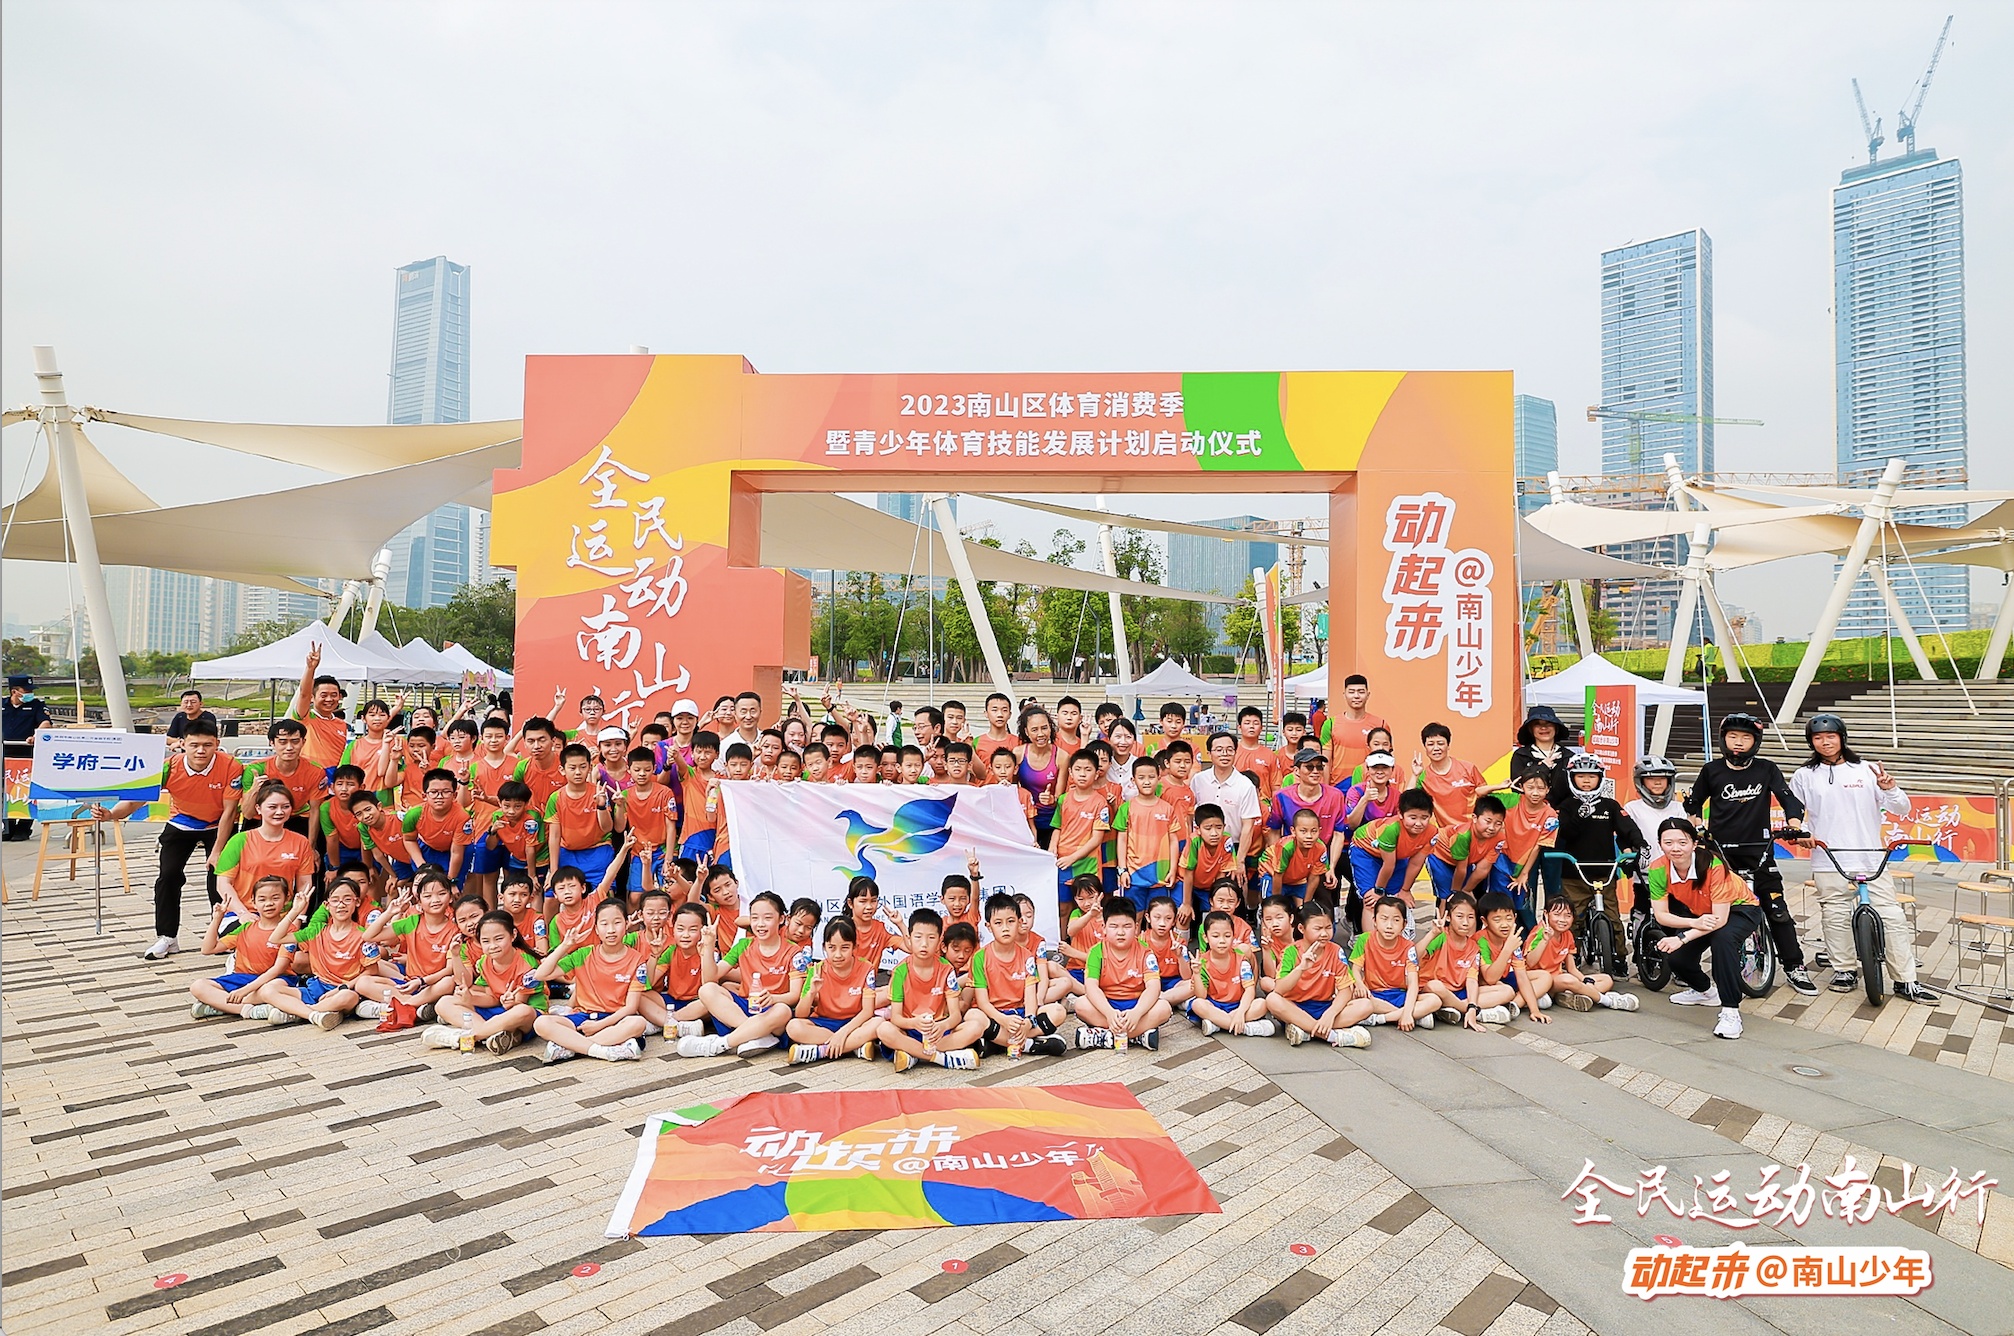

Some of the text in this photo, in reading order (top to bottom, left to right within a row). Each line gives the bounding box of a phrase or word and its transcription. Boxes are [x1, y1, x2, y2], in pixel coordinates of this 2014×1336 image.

[900, 391, 1185, 418] 2023南山区体育消费季
[825, 429, 1262, 457] 暨青少年体育技能发展计划启动仪式
[1391, 501, 1447, 651] 动起来
[1454, 556, 1485, 709] @南山少年
[52, 752, 146, 772] 学府二小
[893, 1149, 1085, 1174] @南山少年
